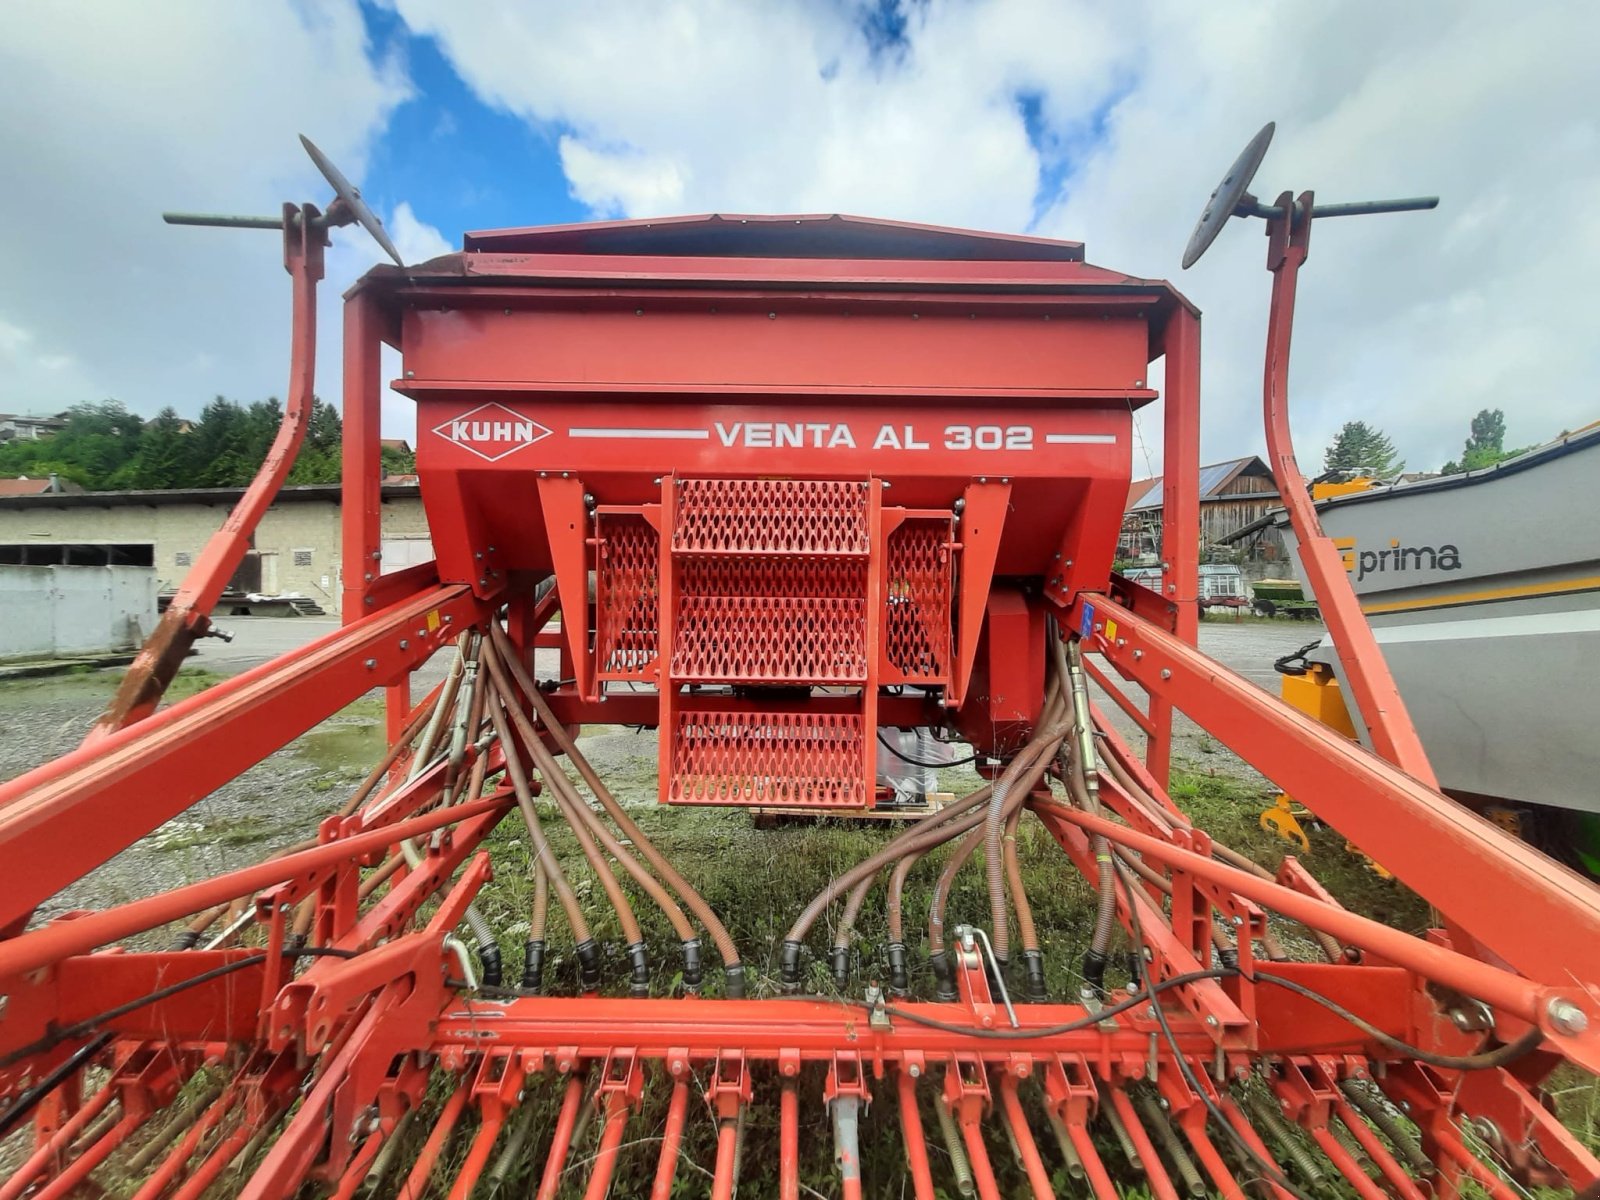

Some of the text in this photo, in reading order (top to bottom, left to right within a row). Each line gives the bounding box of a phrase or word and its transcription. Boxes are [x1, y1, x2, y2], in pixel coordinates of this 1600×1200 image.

[452, 421, 533, 442] KUHN
[714, 422, 1034, 451] VENTA AL 302
